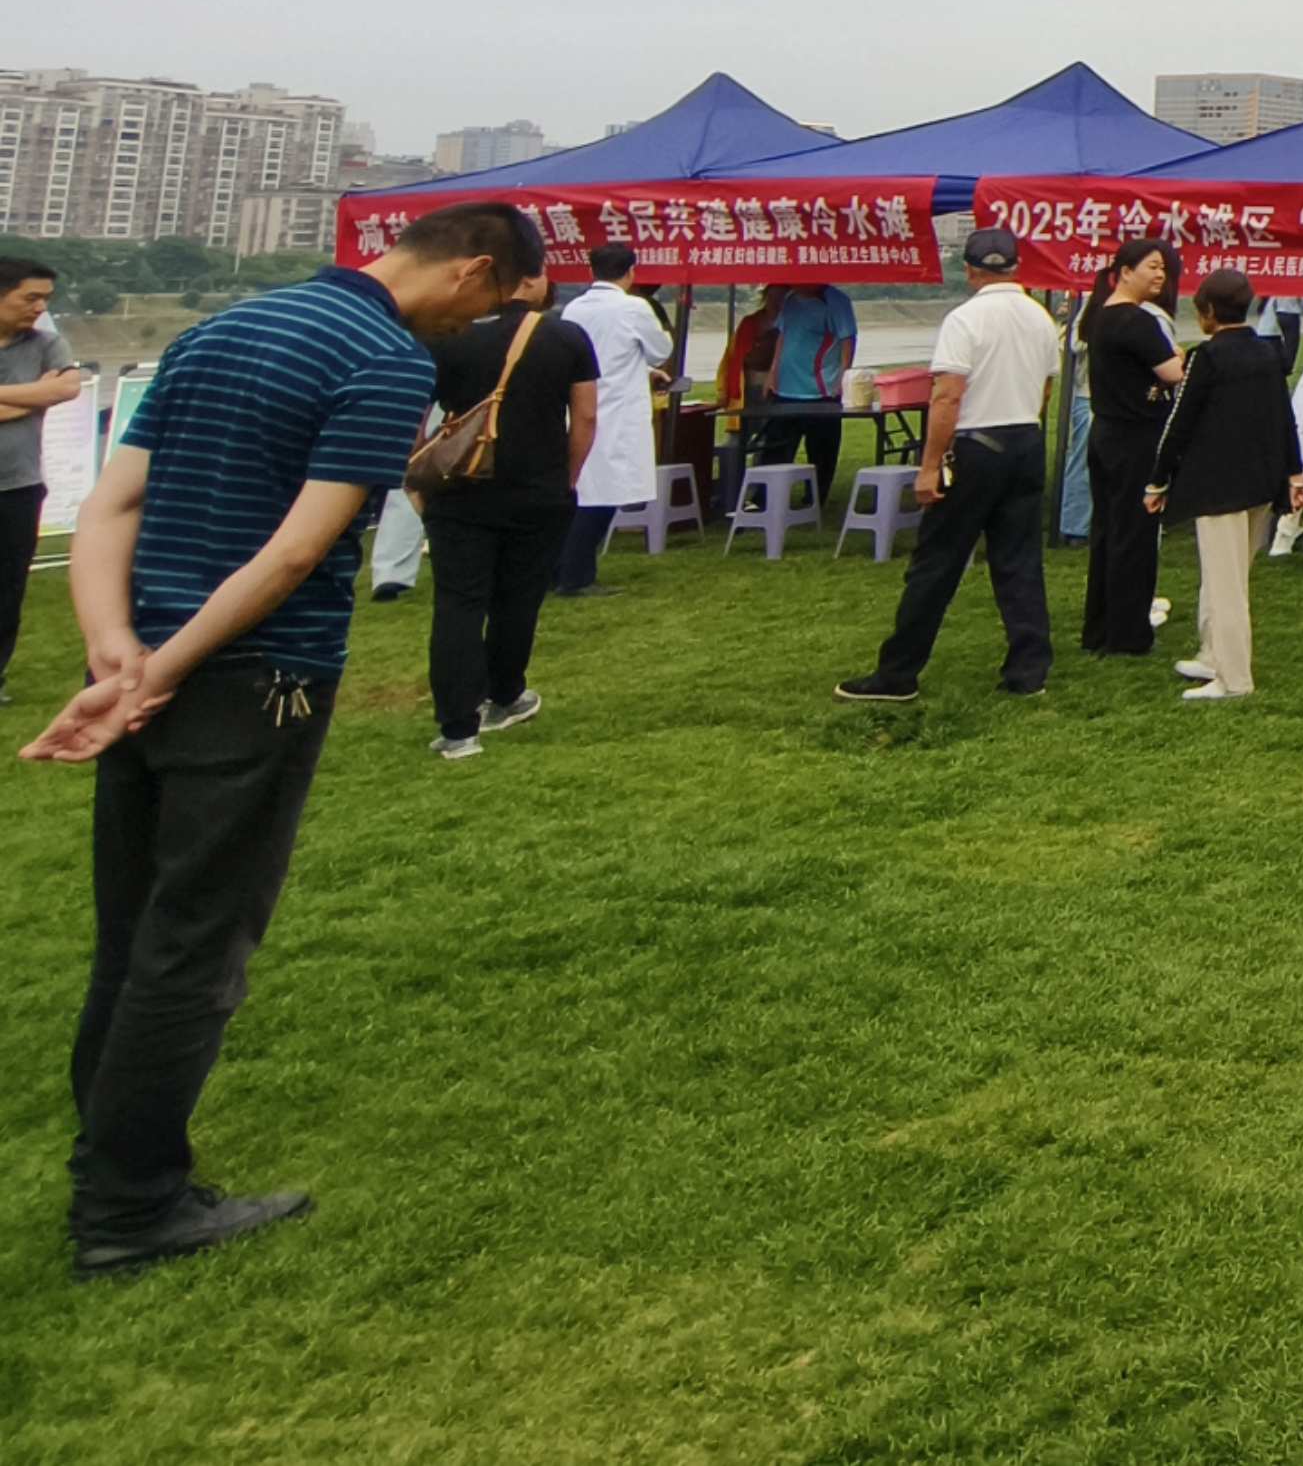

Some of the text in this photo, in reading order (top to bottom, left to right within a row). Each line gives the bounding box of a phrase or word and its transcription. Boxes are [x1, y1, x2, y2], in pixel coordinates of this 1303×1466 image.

[598, 194, 914, 242] 全民共建健康冷水滩
